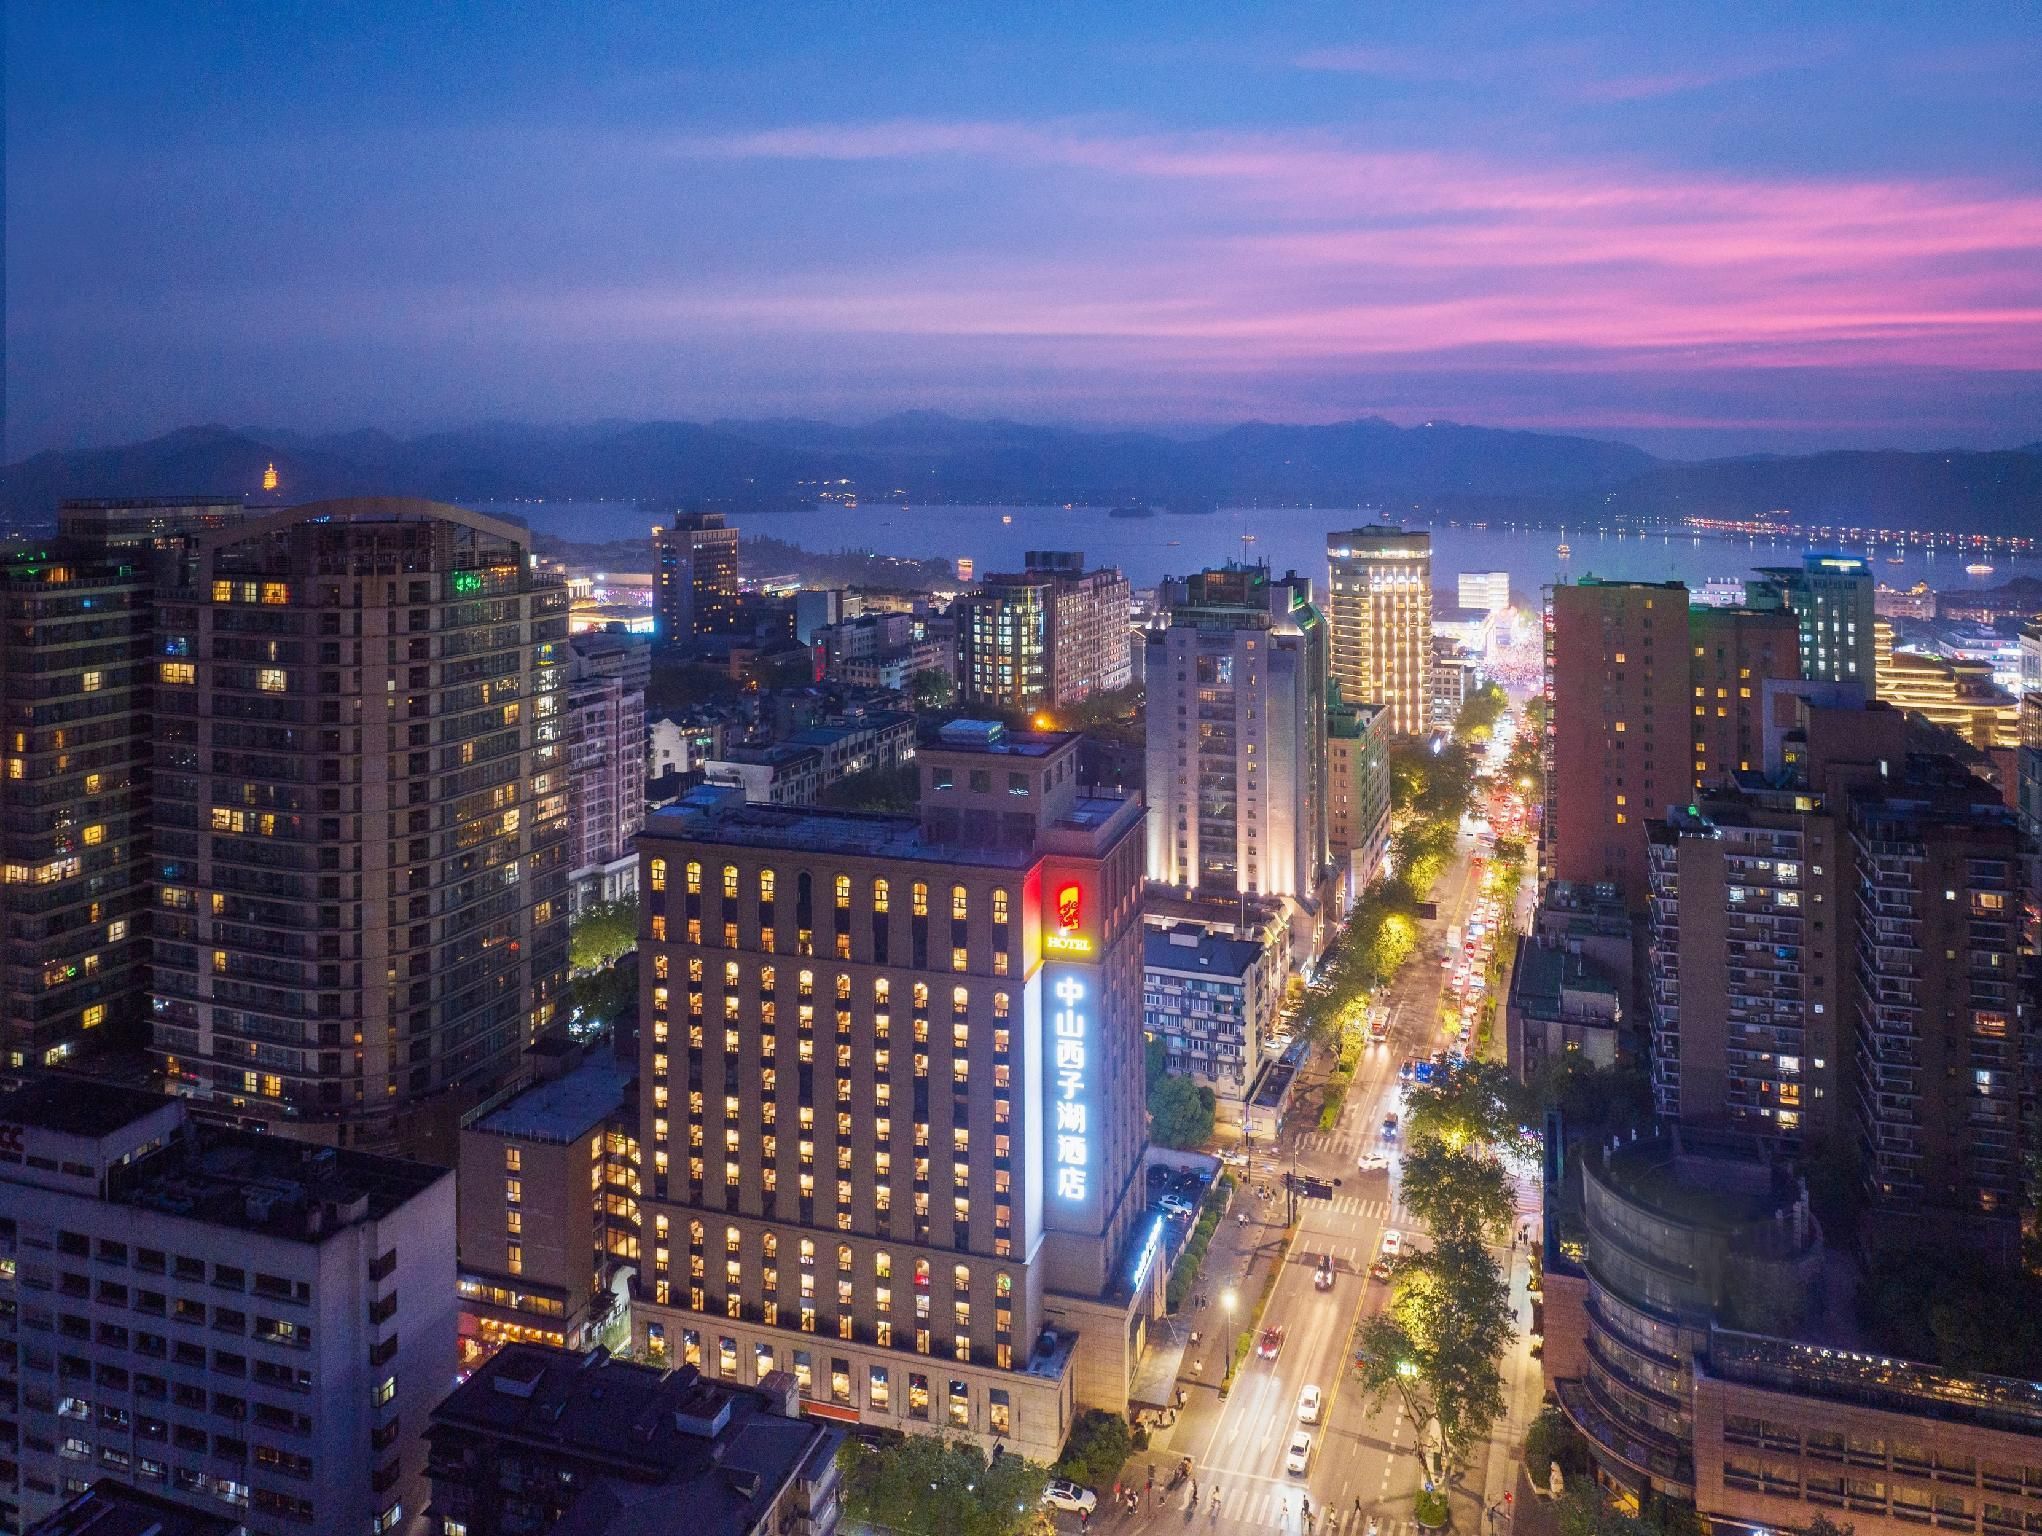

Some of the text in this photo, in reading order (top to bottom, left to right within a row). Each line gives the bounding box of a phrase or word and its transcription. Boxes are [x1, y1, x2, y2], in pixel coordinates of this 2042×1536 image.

[1047, 936, 1091, 951] HOTEL
[1056, 976, 1087, 1201] 中山西子湖酒店
